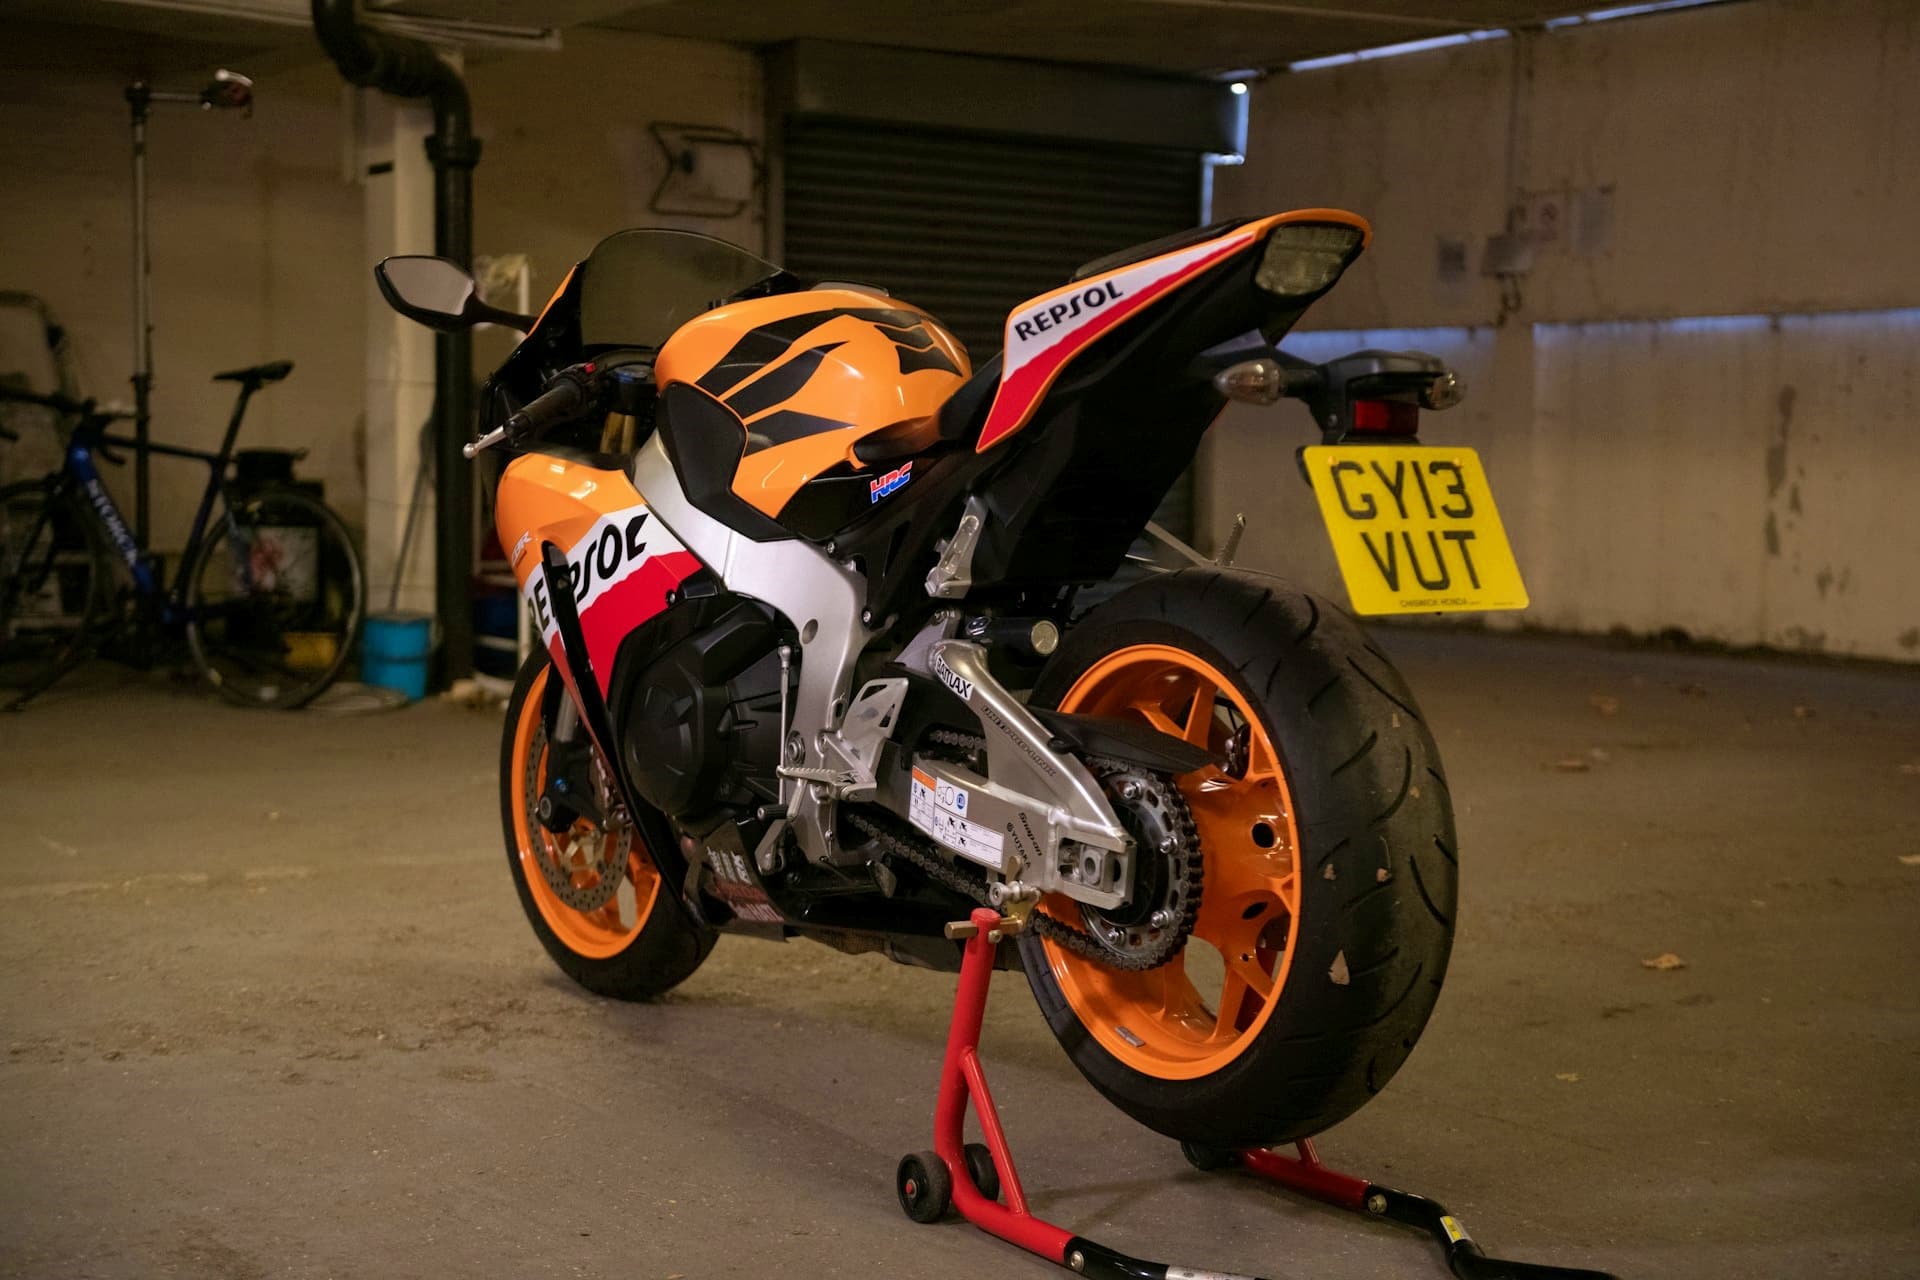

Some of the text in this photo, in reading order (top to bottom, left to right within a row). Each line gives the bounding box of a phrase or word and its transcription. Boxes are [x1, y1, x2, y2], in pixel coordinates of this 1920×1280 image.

[1014, 280, 1124, 342] REPSOL
[870, 461, 913, 504] HRC
[1329, 460, 1475, 521] GY13
[1360, 530, 1481, 593] VUT
